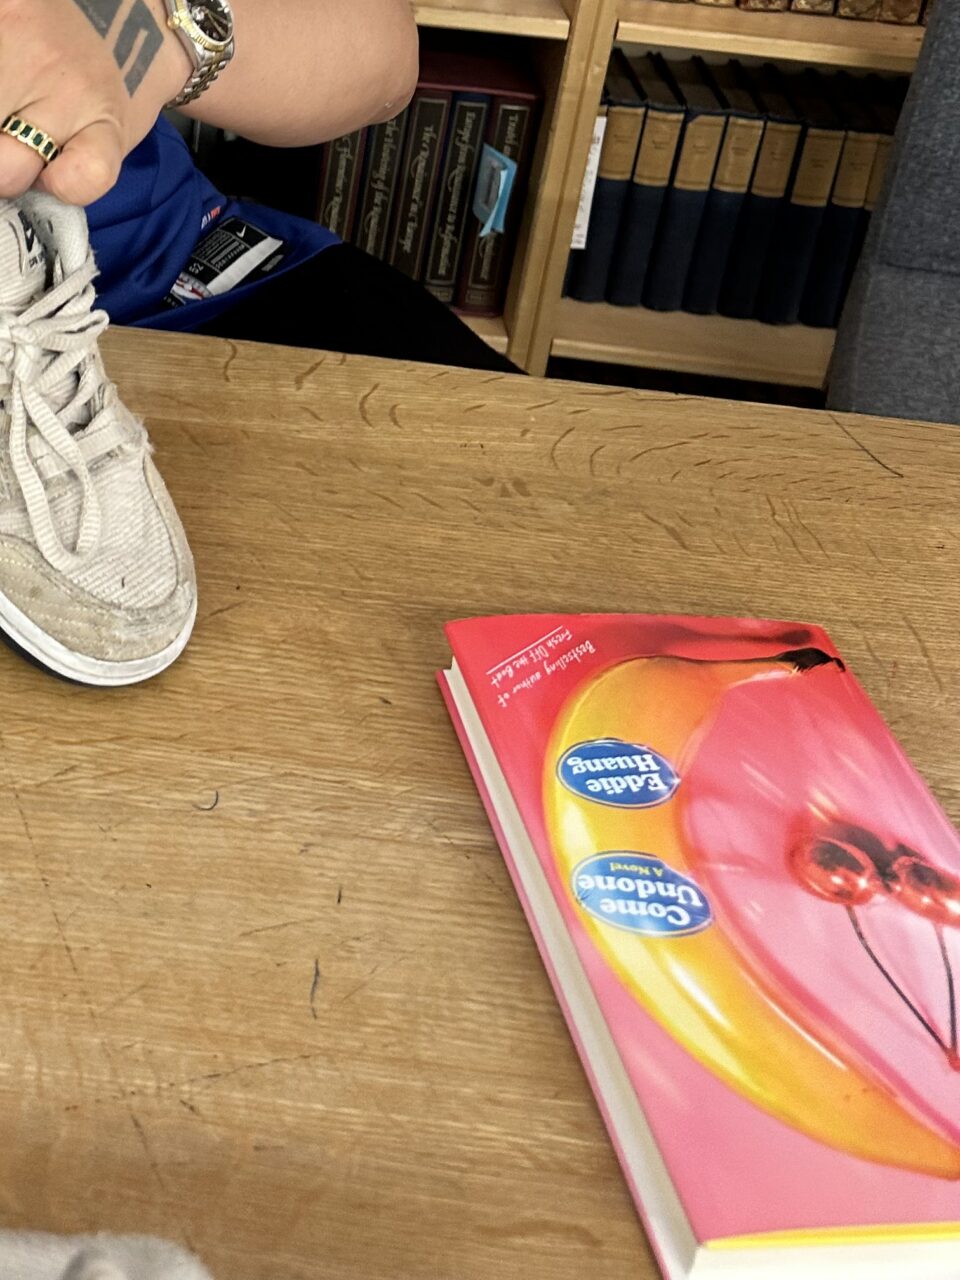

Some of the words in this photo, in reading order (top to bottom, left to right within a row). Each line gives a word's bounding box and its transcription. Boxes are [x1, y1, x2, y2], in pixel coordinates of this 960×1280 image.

[548, 630, 572, 648] Fresh
[513, 656, 528, 668] the
[544, 640, 596, 676] Bestselling
[490, 665, 514, 688] Boat
[512, 672, 542, 694] author
[498, 692, 510, 708] of
[566, 754, 660, 775] Huang
[586, 772, 668, 795] Eddie
[610, 862, 650, 877] Novel
[652, 868, 664, 877] A
[578, 874, 703, 907] Undone
[600, 898, 690, 926] Come
